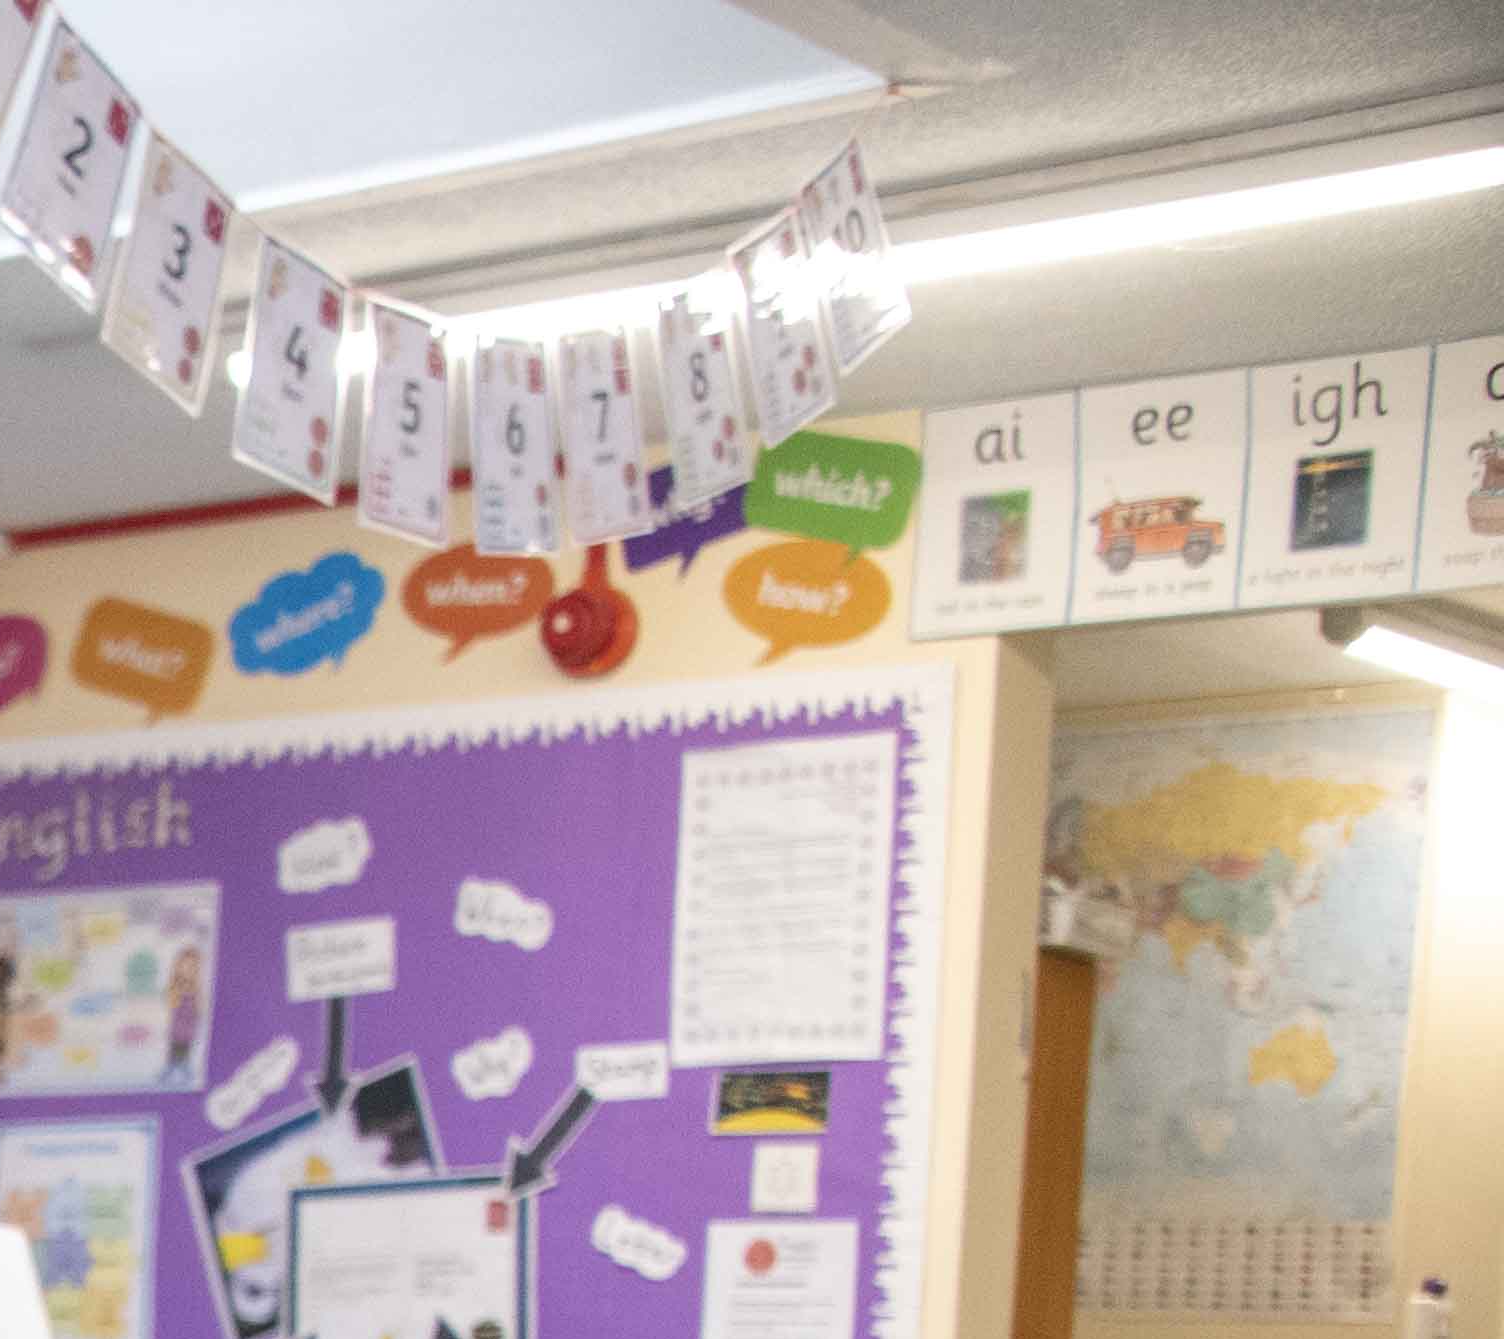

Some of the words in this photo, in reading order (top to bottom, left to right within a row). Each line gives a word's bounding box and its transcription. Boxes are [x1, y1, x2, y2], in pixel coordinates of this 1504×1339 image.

[64, 116, 95, 178] 2
[164, 223, 191, 280] 3
[285, 324, 310, 382] 4
[690, 351, 709, 402] 8
[399, 380, 421, 434] 5
[505, 403, 526, 454] 6
[591, 389, 609, 443] 7
[1131, 400, 1196, 446] ee
[1291, 361, 1388, 447] igh
[974, 408, 1029, 465] ai
[774, 463, 893, 512] which?
[423, 570, 531, 608] when?
[757, 568, 853, 617] how?
